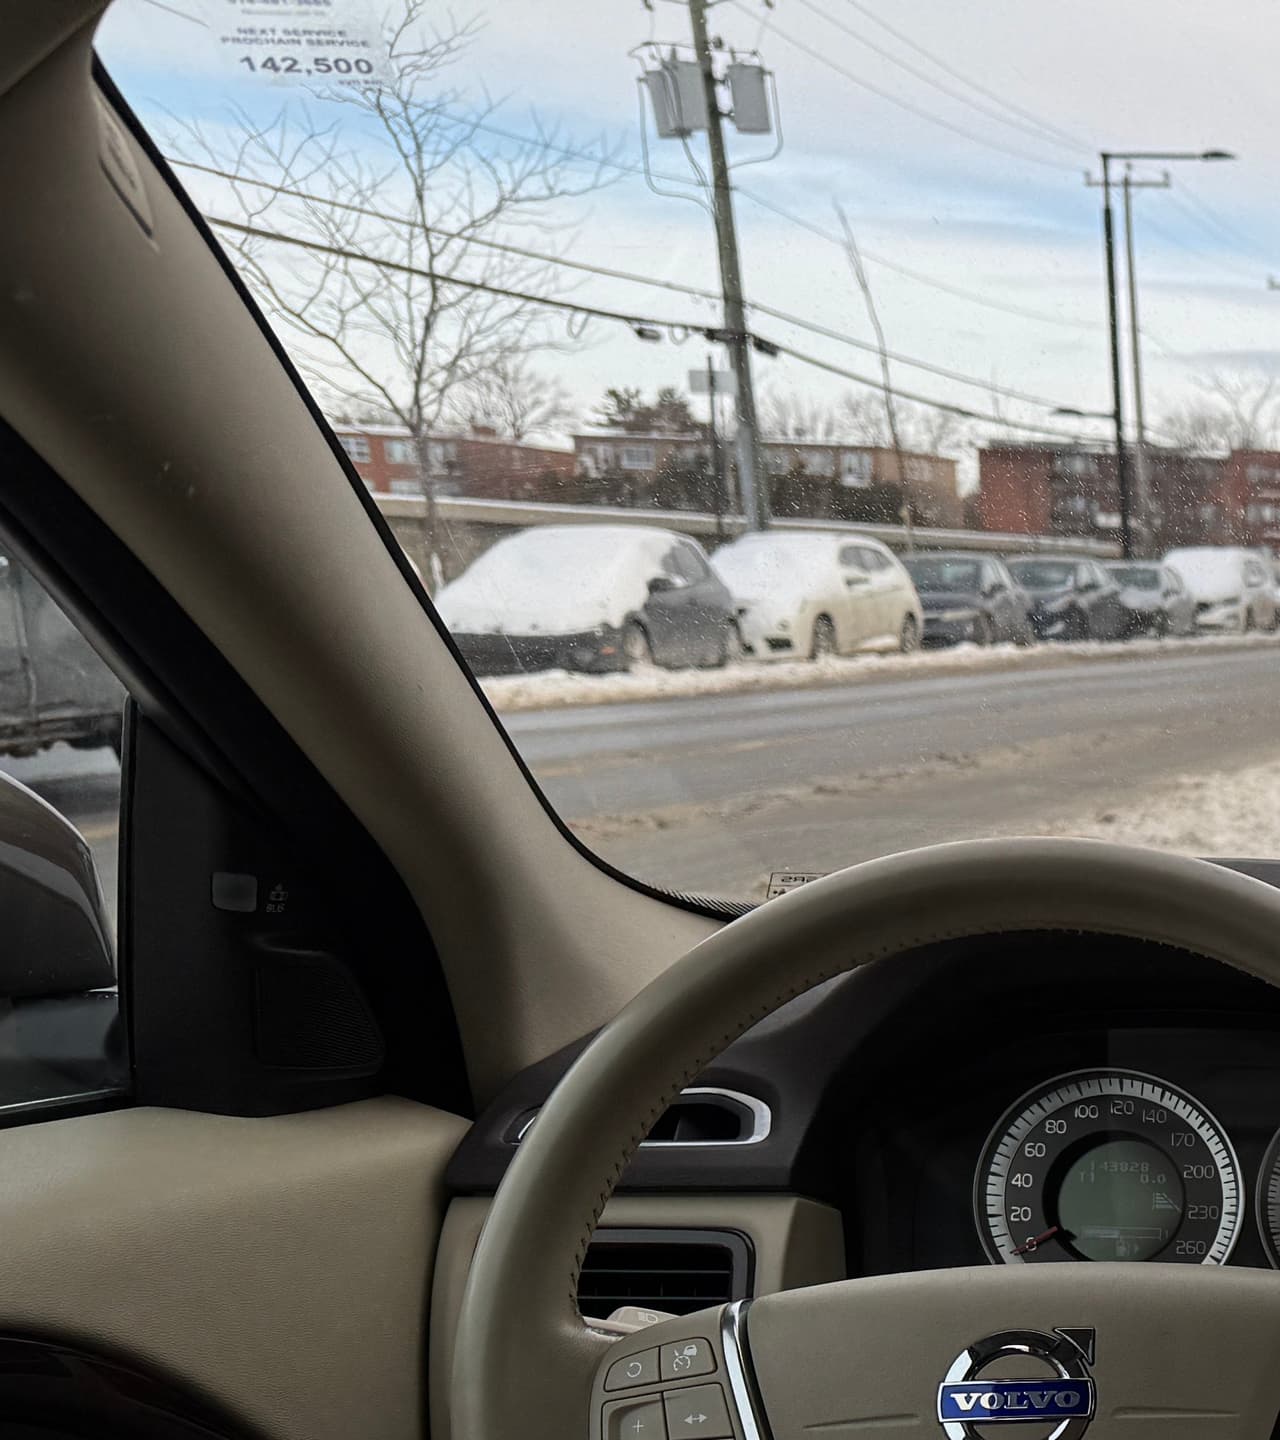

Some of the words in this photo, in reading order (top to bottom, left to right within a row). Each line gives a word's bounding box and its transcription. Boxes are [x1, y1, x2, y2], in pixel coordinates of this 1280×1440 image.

[237, 27, 276, 36] NEXT
[282, 28, 347, 37] SERVICE
[221, 36, 302, 46] PROCHAIN
[305, 39, 370, 48] SERVICE
[239, 56, 374, 76] 142,500
[1074, 1105, 1099, 1118] 100
[1110, 1101, 1135, 1115] 120
[1142, 1109, 1167, 1123] 140
[1045, 1120, 1067, 1134] 80
[1171, 1132, 1195, 1147] 170
[1024, 1143, 1046, 1157] 60
[1183, 1165, 1215, 1179] 200
[1011, 1173, 1033, 1188] 40
[1010, 1206, 1032, 1221] 20
[1187, 1205, 1219, 1220] 230
[1175, 1240, 1207, 1255] 260
[951, 1391, 1080, 1411] VOLVO
